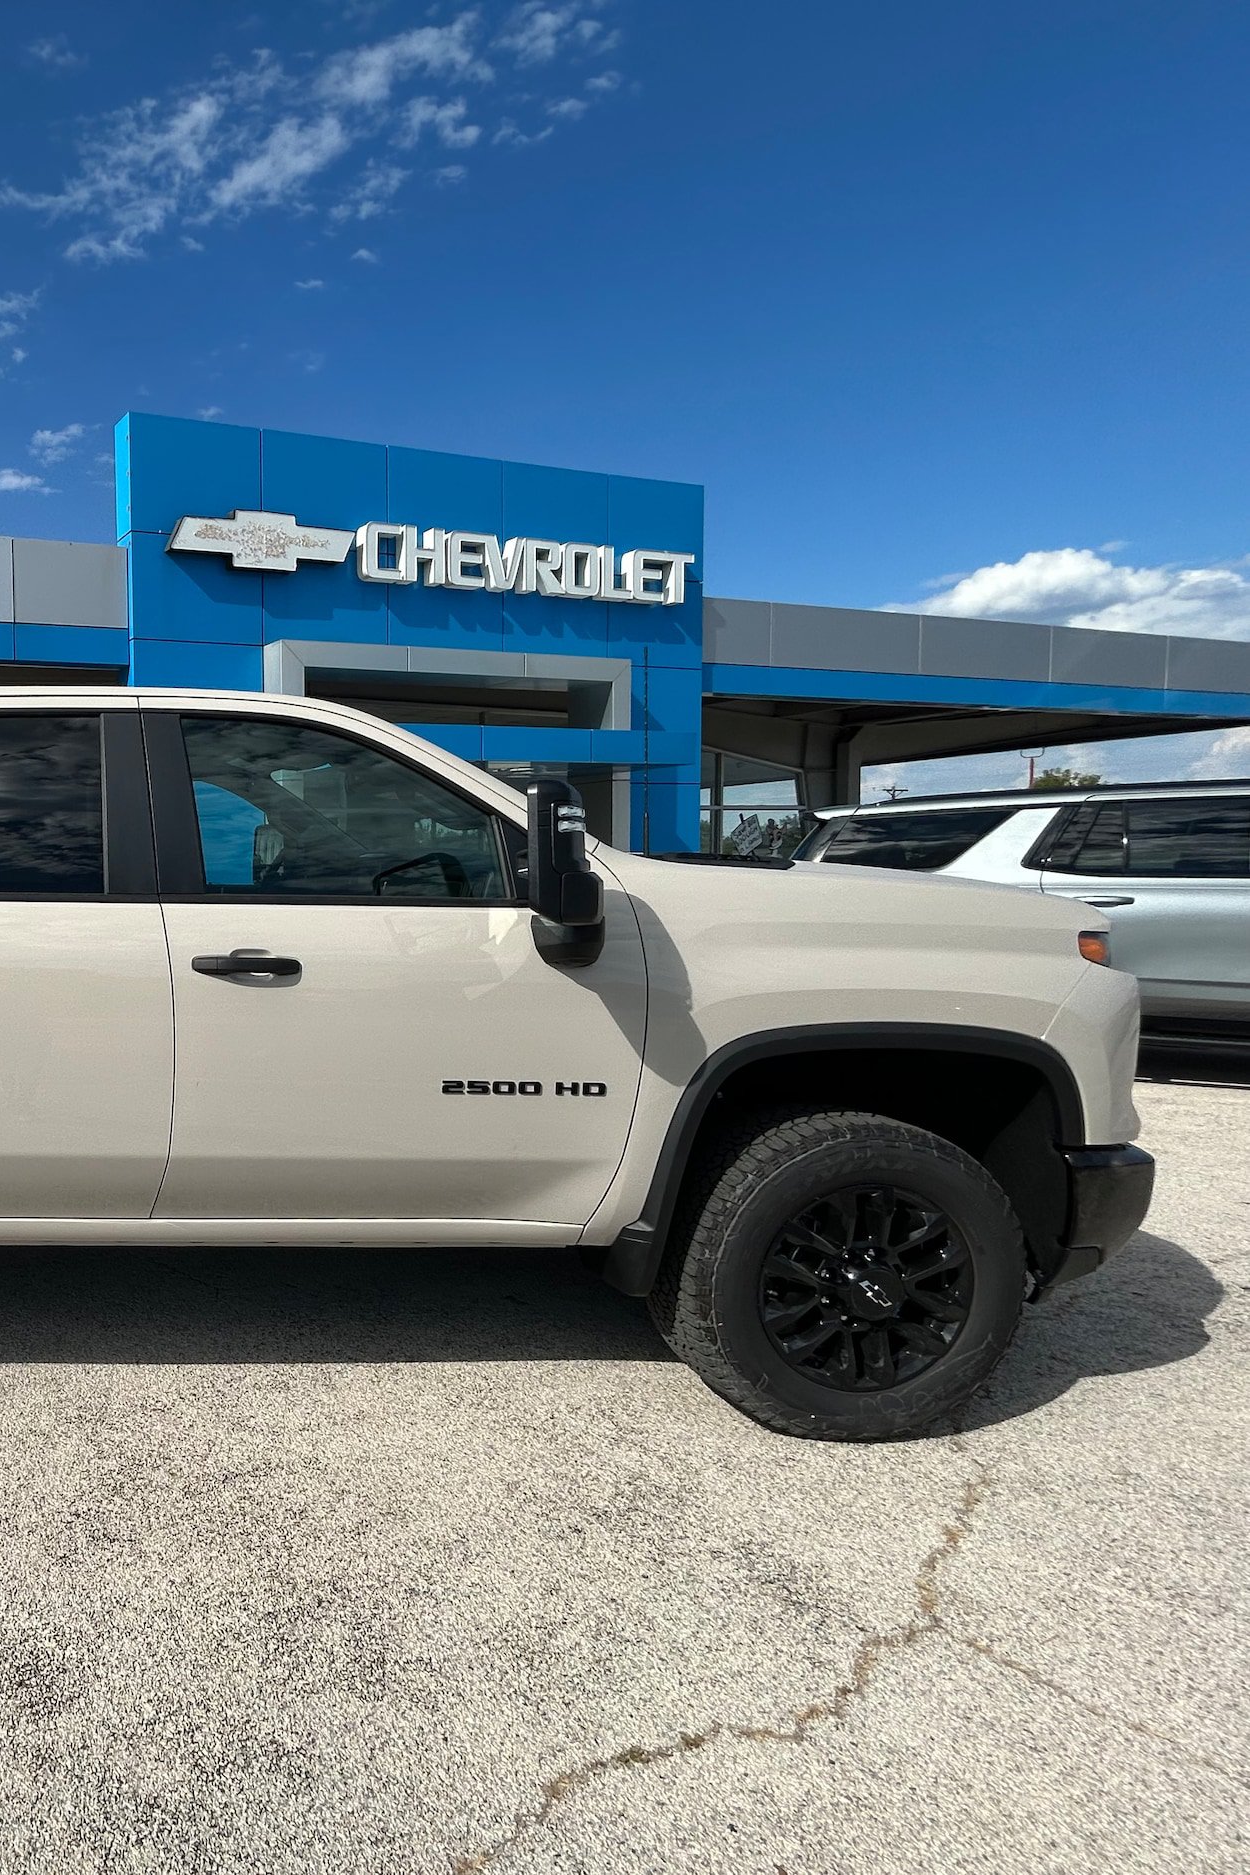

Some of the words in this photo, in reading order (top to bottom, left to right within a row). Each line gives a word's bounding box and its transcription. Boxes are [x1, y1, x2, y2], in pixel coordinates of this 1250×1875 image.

[356, 520, 695, 605] CHEVROLET
[442, 1080, 543, 1096] 2500
[555, 1081, 608, 1097] HD
